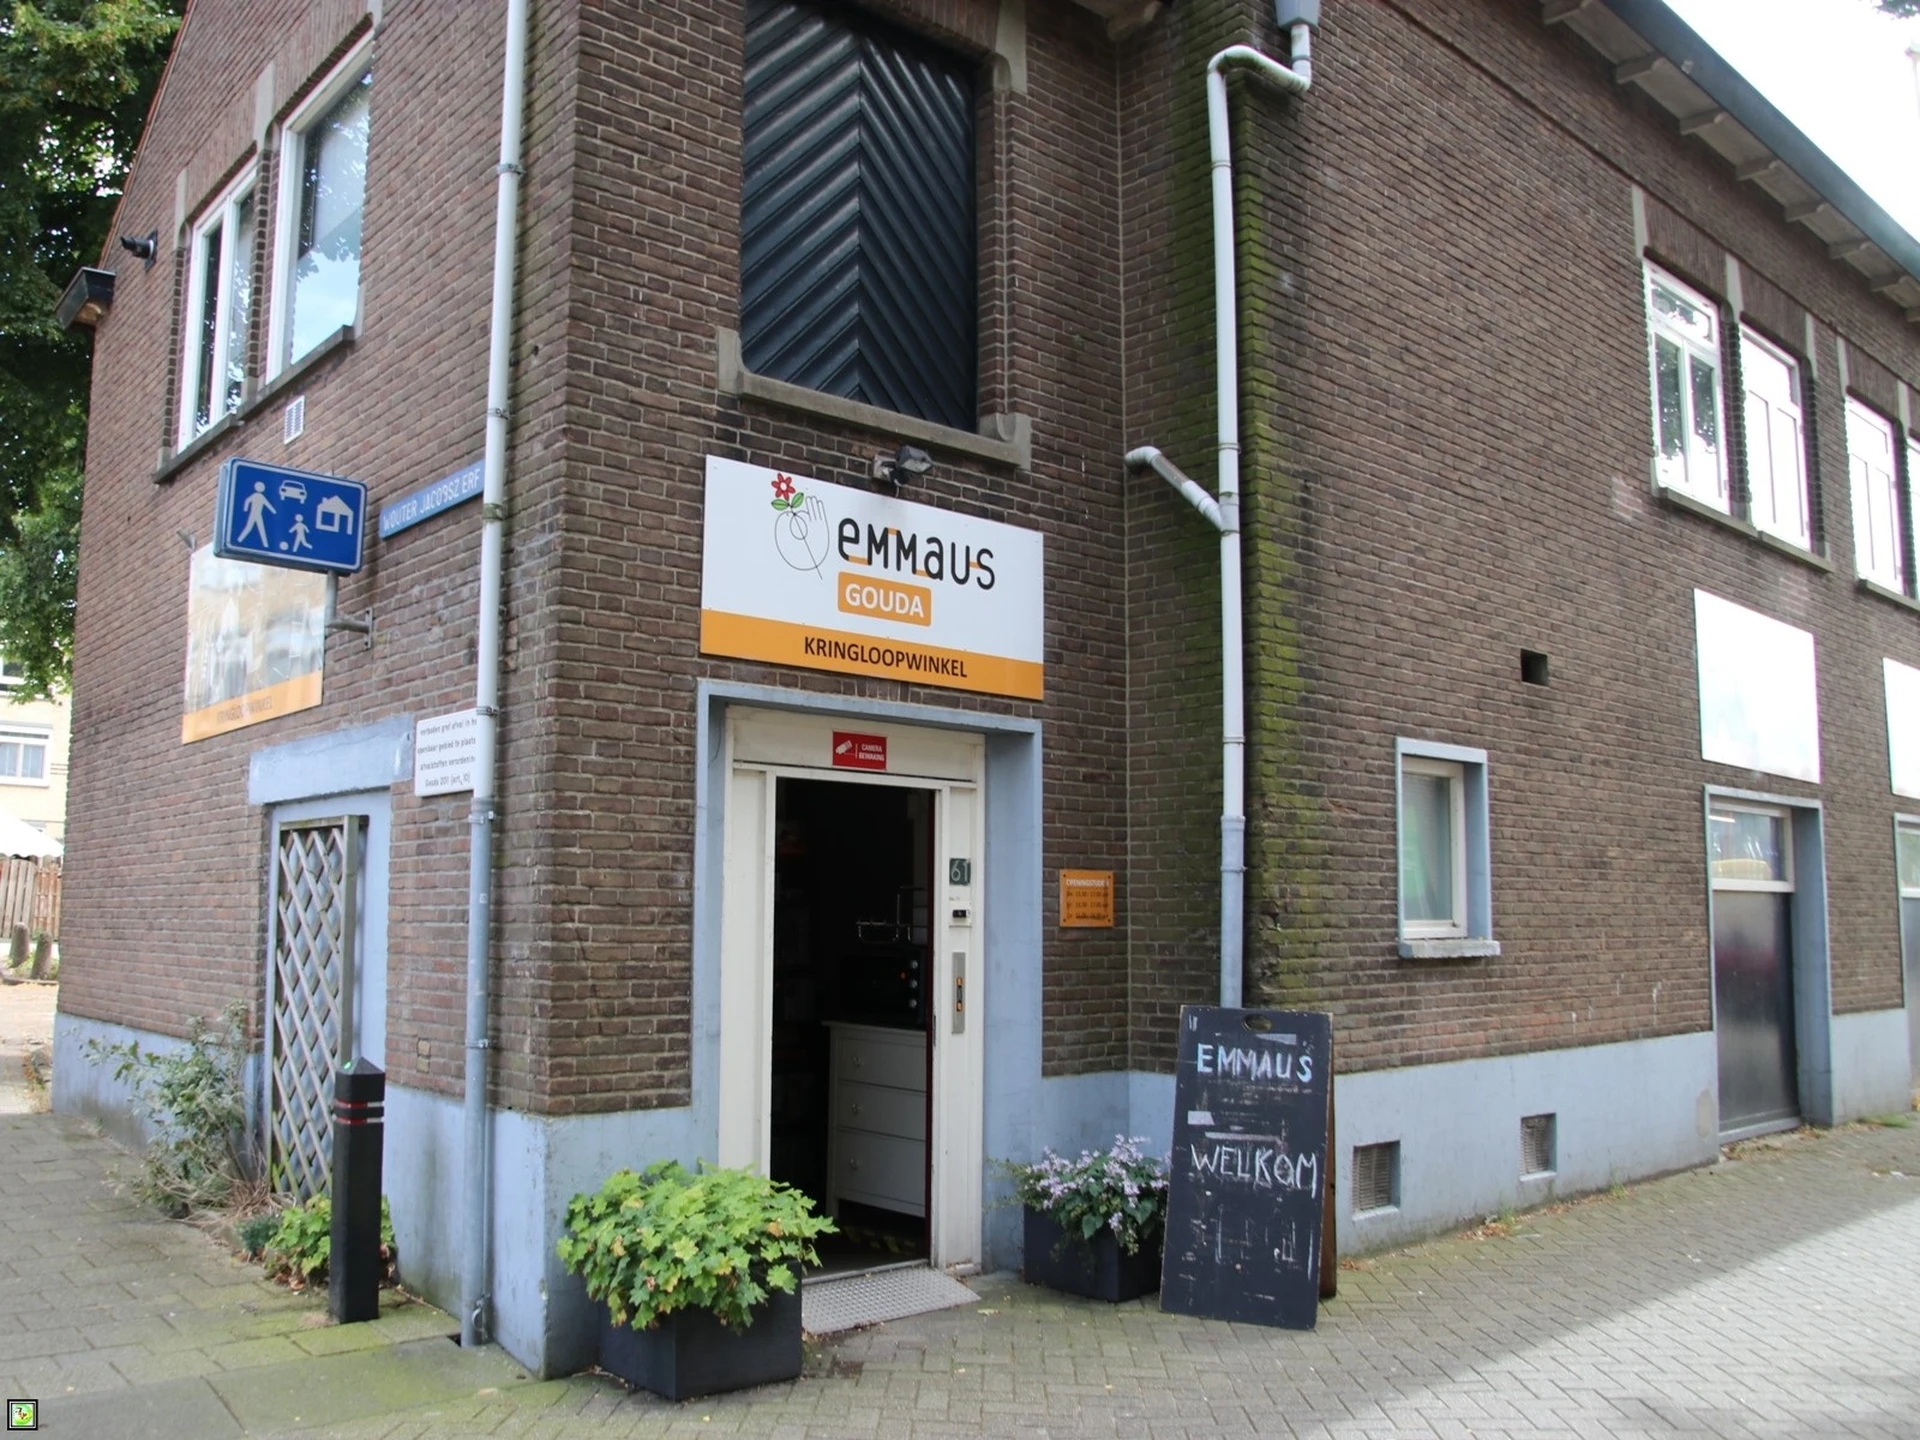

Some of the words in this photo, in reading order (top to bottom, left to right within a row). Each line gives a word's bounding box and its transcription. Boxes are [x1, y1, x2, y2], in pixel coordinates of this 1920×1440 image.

[383, 500, 418, 531] WOUTER
[420, 479, 460, 514] JACOBSZ
[462, 468, 481, 494] ERF
[844, 583, 925, 619] GOUDA
[803, 636, 969, 678] KRINGLOOPWINKEL
[858, 752, 885, 761] BEWAKING
[861, 743, 883, 753] CAMERA
[951, 860, 969, 882] 61
[1196, 1043, 1313, 1083] EMMAUS
[1190, 1144, 1318, 1199] WELKOM
